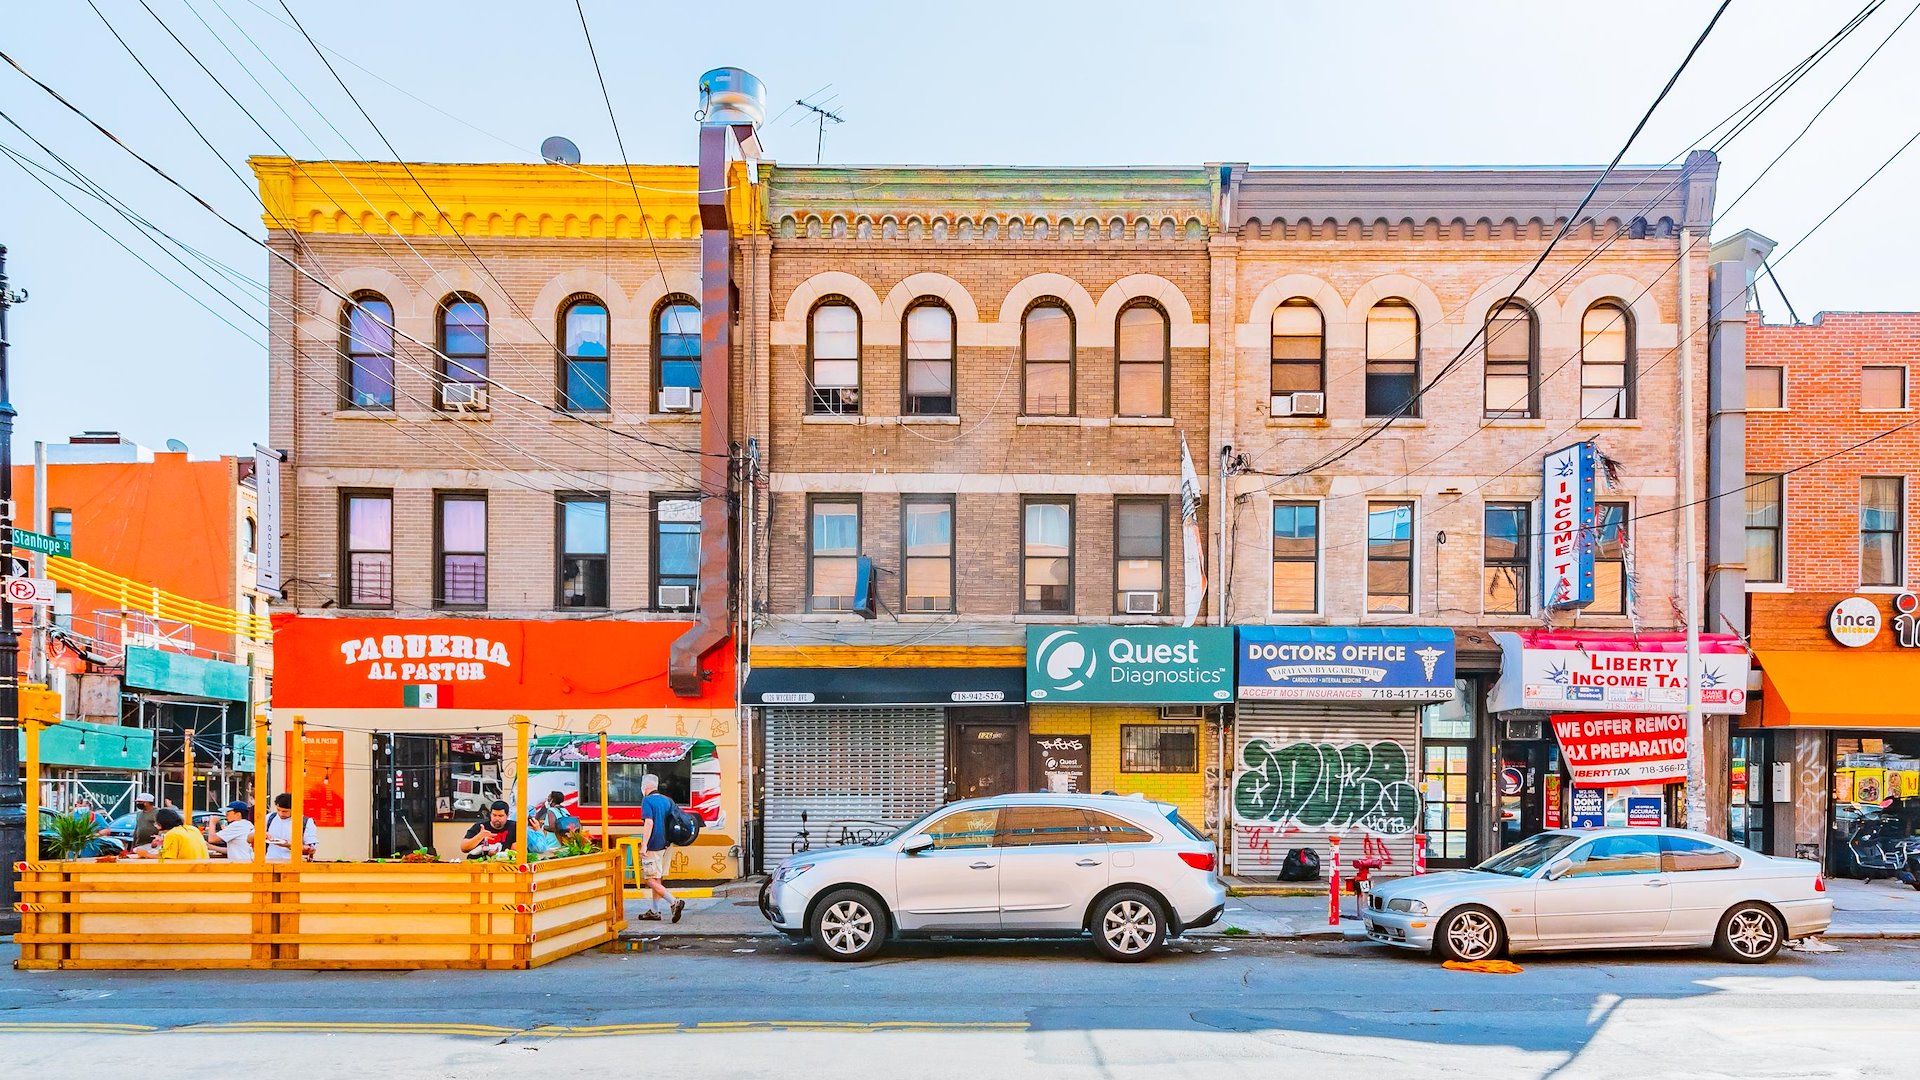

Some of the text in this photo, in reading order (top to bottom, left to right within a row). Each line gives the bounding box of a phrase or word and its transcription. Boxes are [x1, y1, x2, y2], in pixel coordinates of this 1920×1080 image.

[1554, 481, 1572, 557] INCOME
[14, 529, 70, 555] Stanhope St
[1836, 608, 1876, 627] inca
[1835, 626, 1875, 634] chicken
[340, 634, 511, 668] TAQUERIA
[1108, 638, 1200, 665] Quest
[1249, 644, 1406, 662] DOCTORS OFFICE
[367, 662, 486, 681] AL PASTOR
[1591, 653, 1679, 672] LIBERTY
[1572, 671, 1648, 687] INCOME
[953, 692, 1003, 700] 718-942-5262
[1243, 688, 1363, 698] ACCEPT MOST INSURANCES
[1372, 689, 1453, 698] 718-417-1456
[1556, 714, 1687, 738] WE OFFER REMOT
[1573, 798, 1602, 806] DON'T
